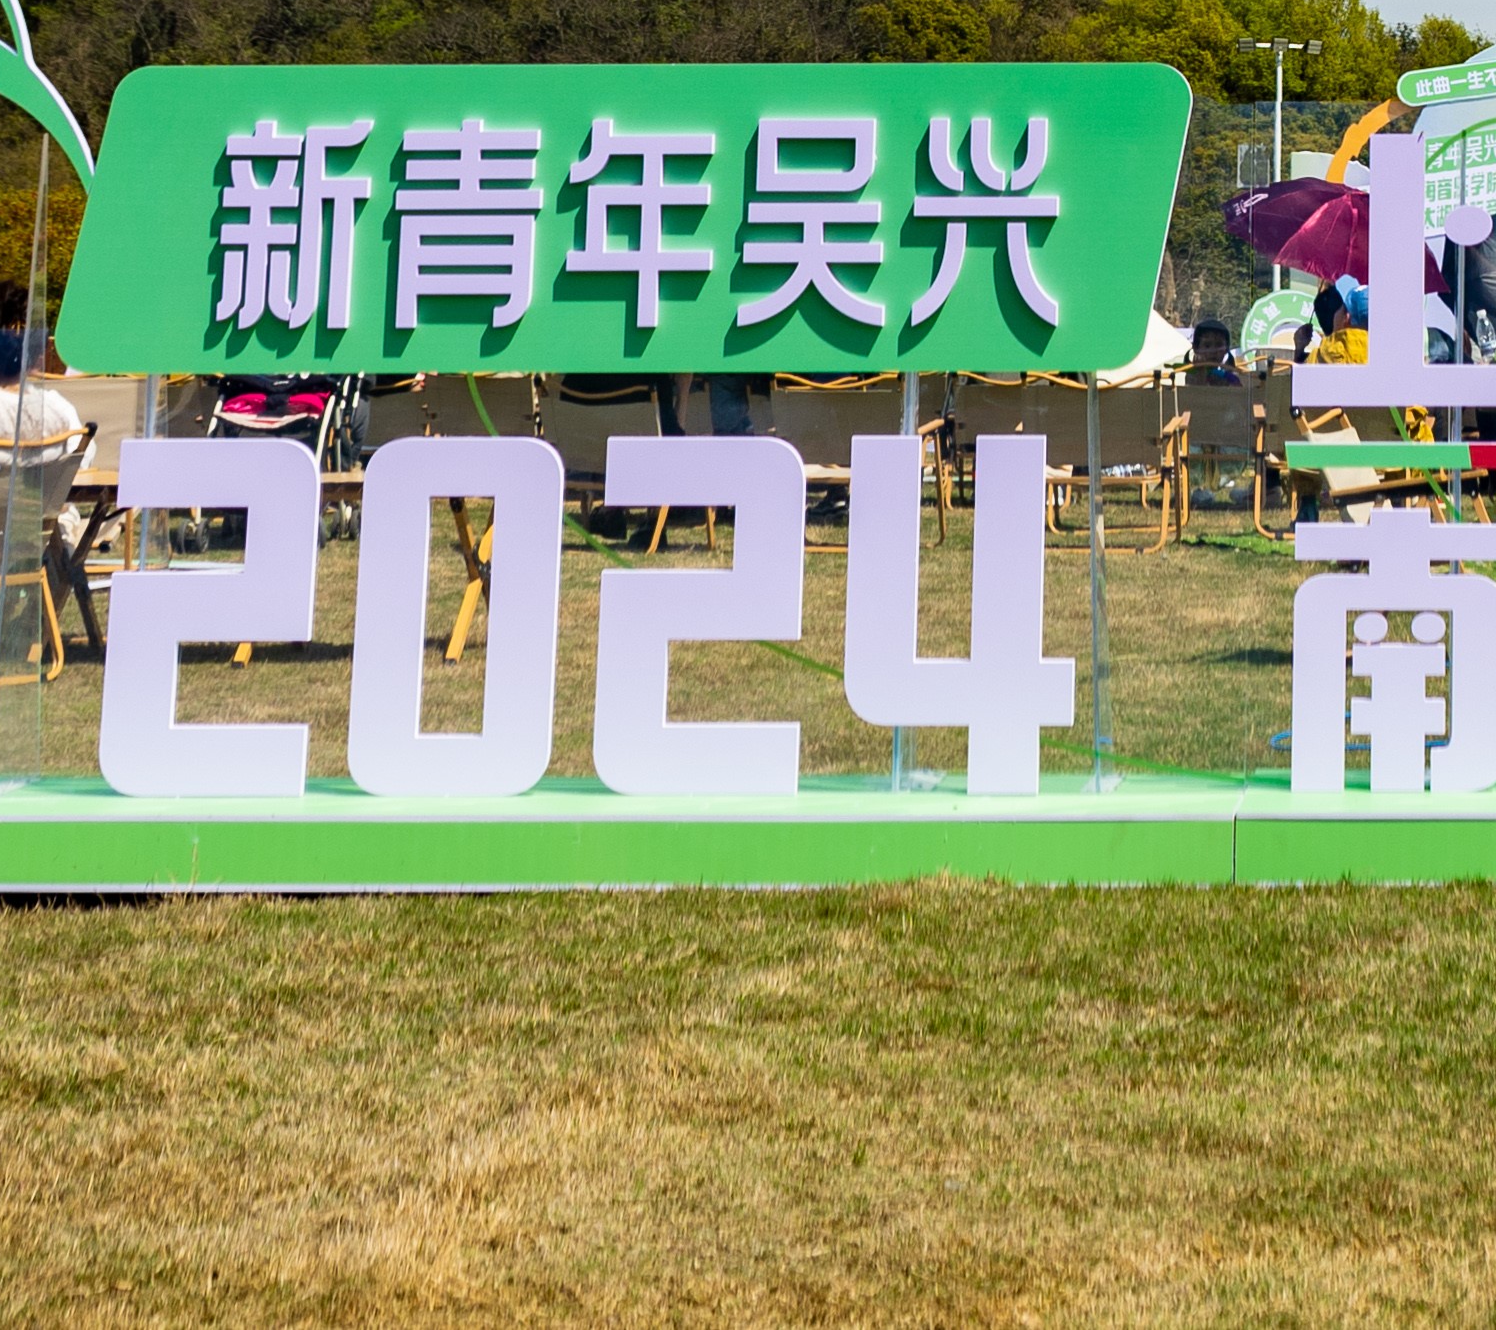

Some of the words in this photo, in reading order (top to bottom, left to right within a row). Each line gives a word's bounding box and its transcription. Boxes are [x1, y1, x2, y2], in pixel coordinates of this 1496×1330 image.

[215, 117, 1061, 332] 新青年吴兴
[98, 434, 1077, 798] 2024
